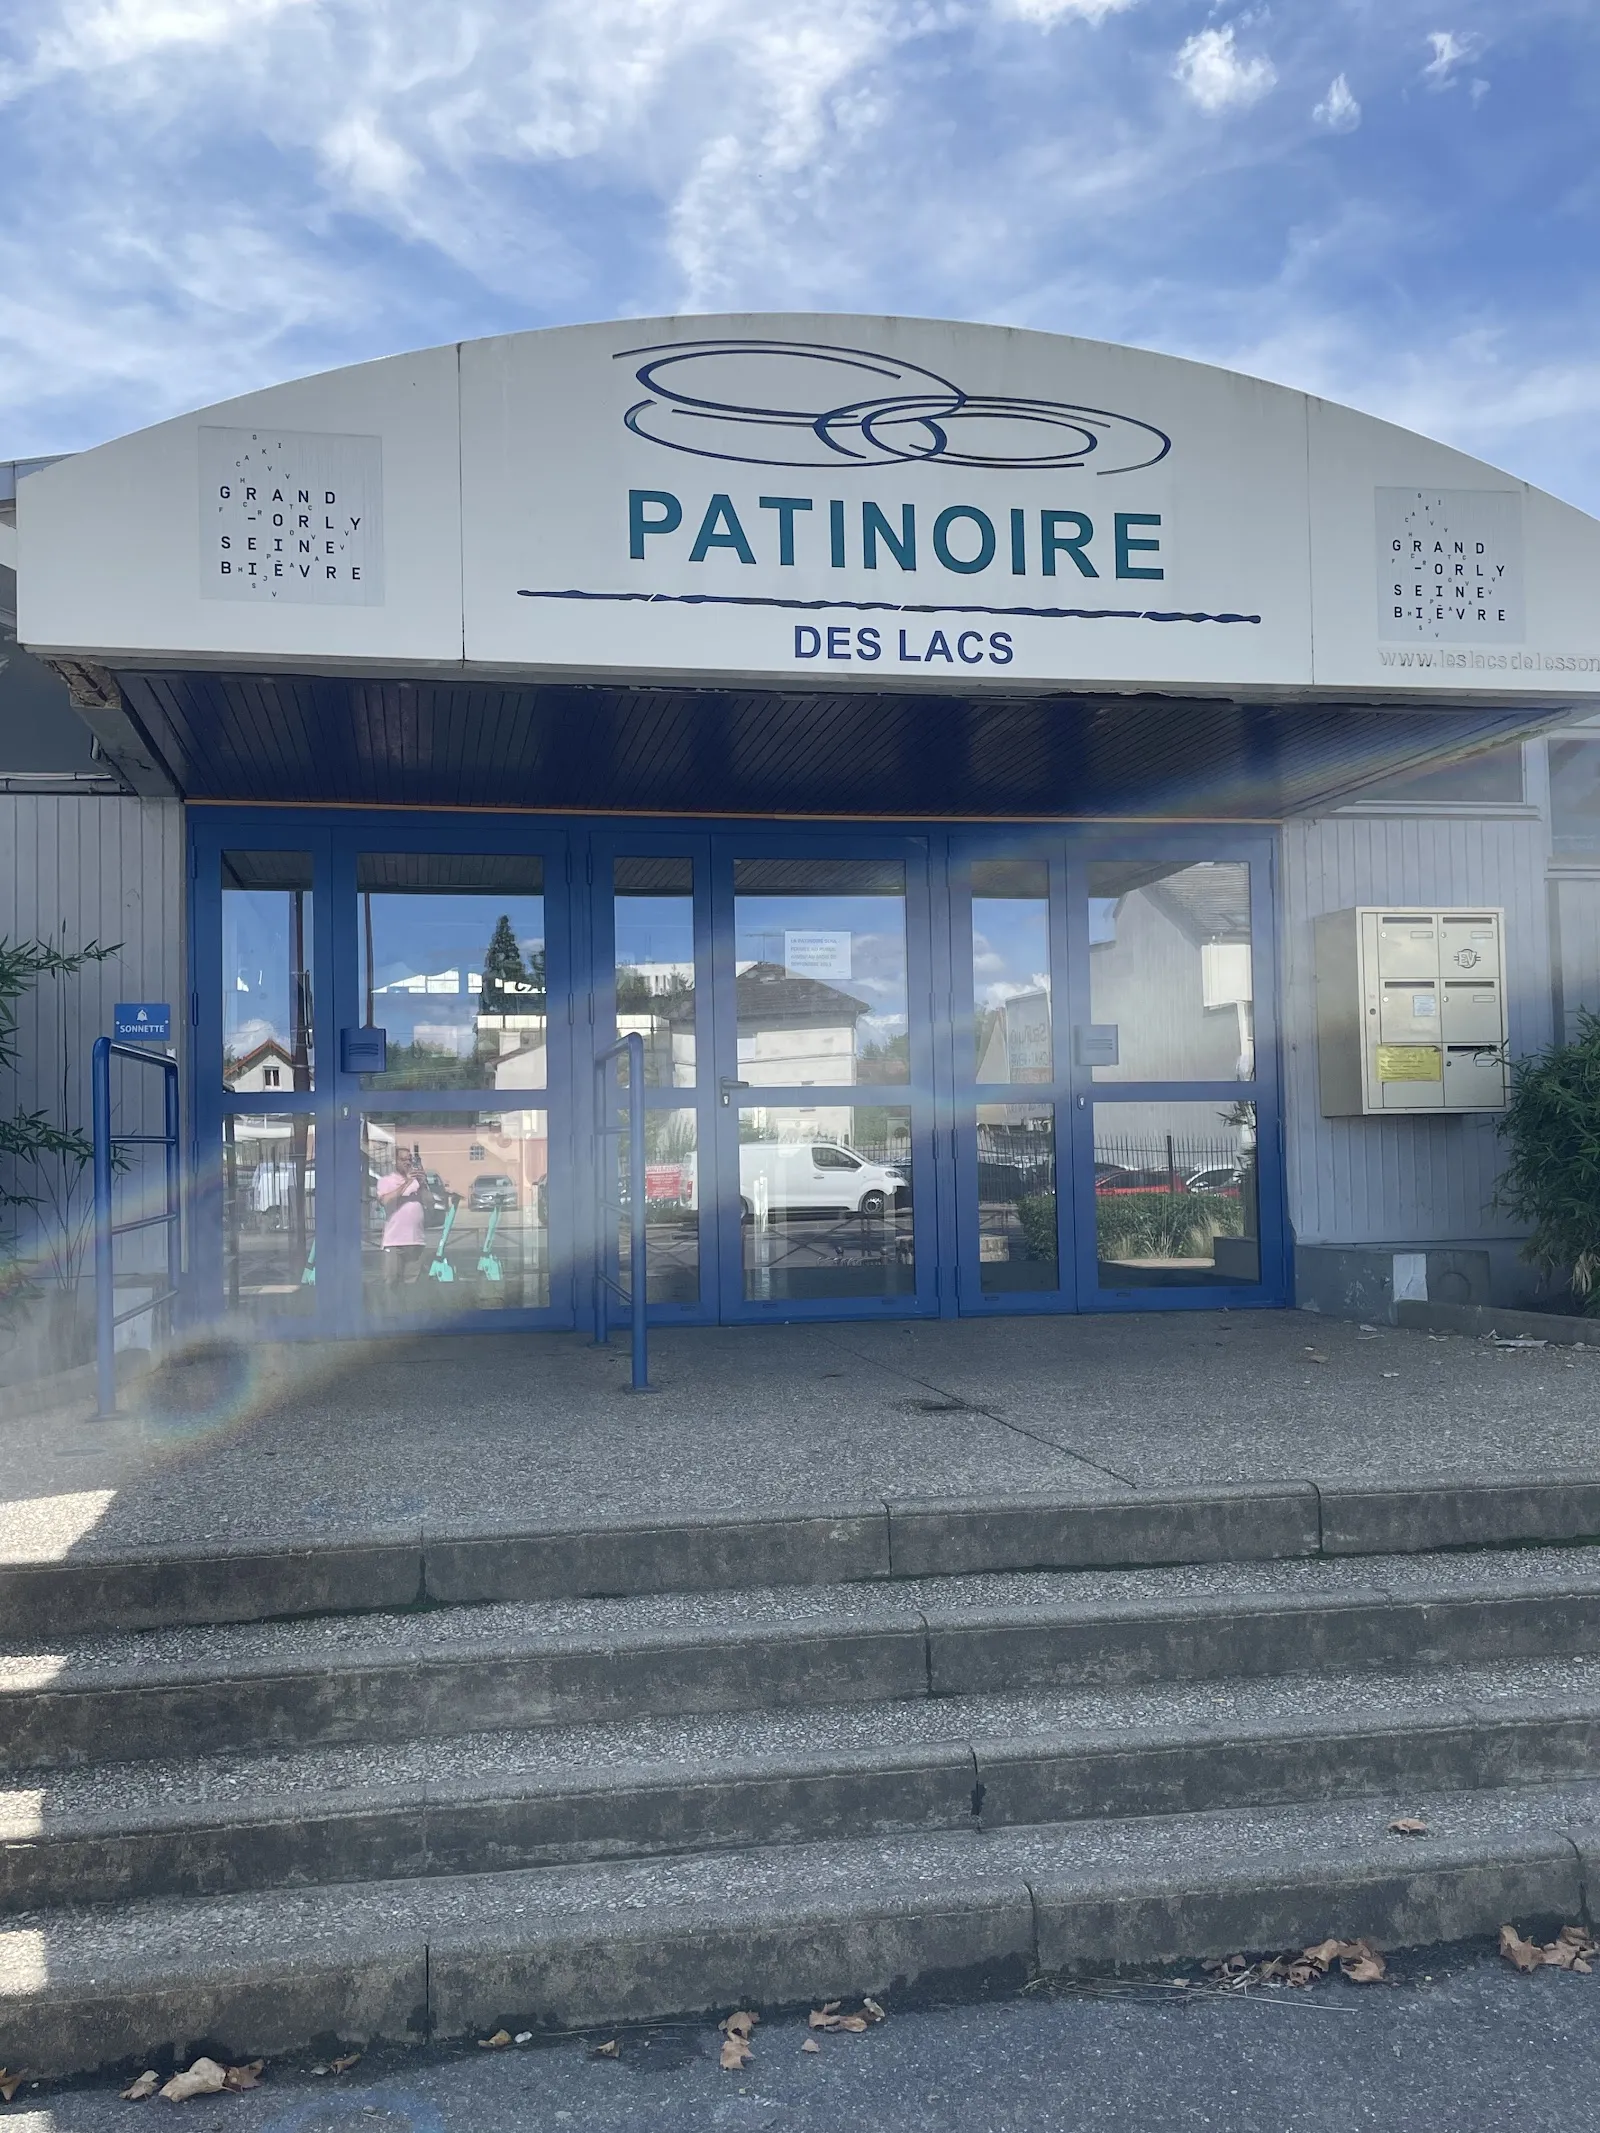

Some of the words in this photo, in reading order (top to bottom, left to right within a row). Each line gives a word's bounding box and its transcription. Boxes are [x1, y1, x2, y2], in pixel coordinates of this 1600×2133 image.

[220, 486, 335, 504] GRAND
[629, 489, 1164, 581] PATINOIRE
[221, 536, 335, 554] SEINE
[1393, 539, 1484, 554] GRAND
[1394, 584, 1485, 598] SEINE
[794, 625, 881, 661] DES
[899, 629, 1014, 665] LACS
[119, 1024, 165, 1033] SONNETTE
